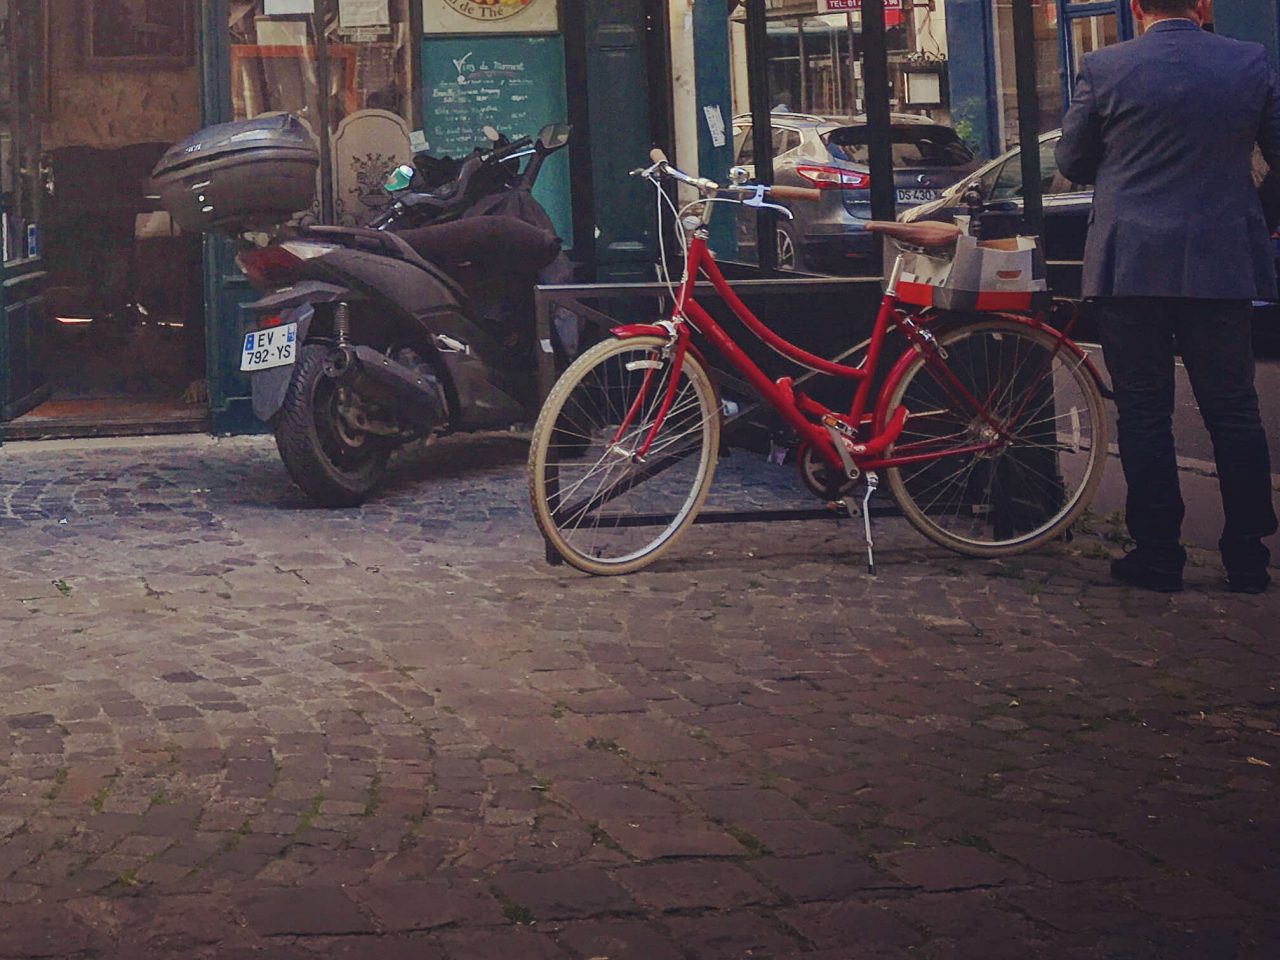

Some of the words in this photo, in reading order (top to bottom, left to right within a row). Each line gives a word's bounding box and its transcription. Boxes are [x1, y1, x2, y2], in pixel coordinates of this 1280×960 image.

[460, 0, 475, 16] de
[477, 5, 504, 19] Thé
[247, 344, 291, 364] 792-YS
